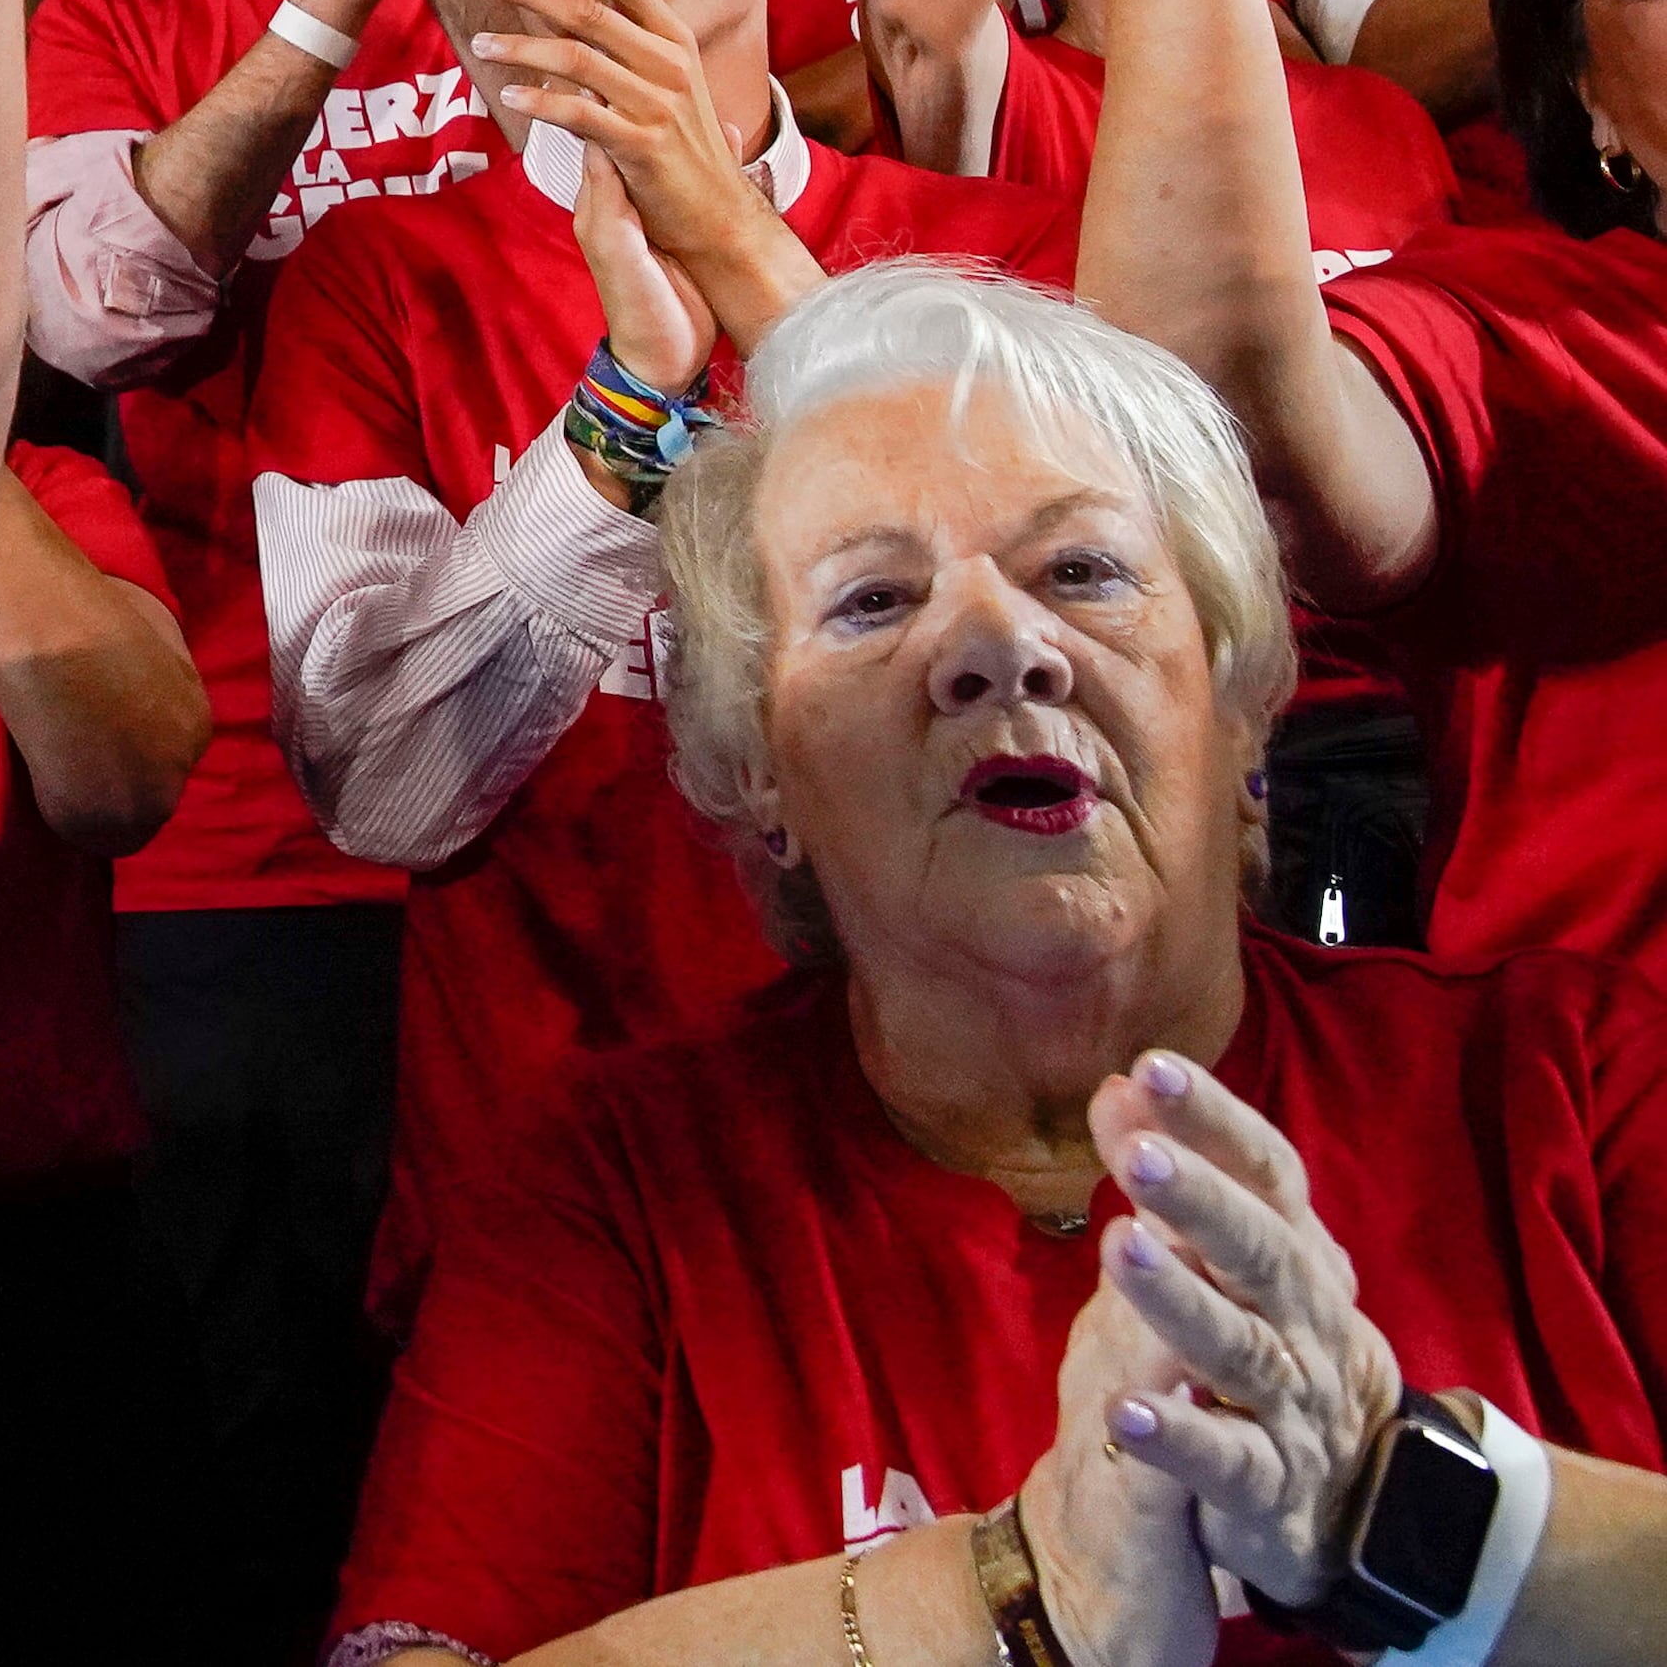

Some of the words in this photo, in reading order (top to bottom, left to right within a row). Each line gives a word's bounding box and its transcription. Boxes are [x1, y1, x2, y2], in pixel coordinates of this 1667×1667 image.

[302, 65, 489, 154] ERZ
[291, 149, 353, 186] LA
[840, 1463, 937, 1542] LA
